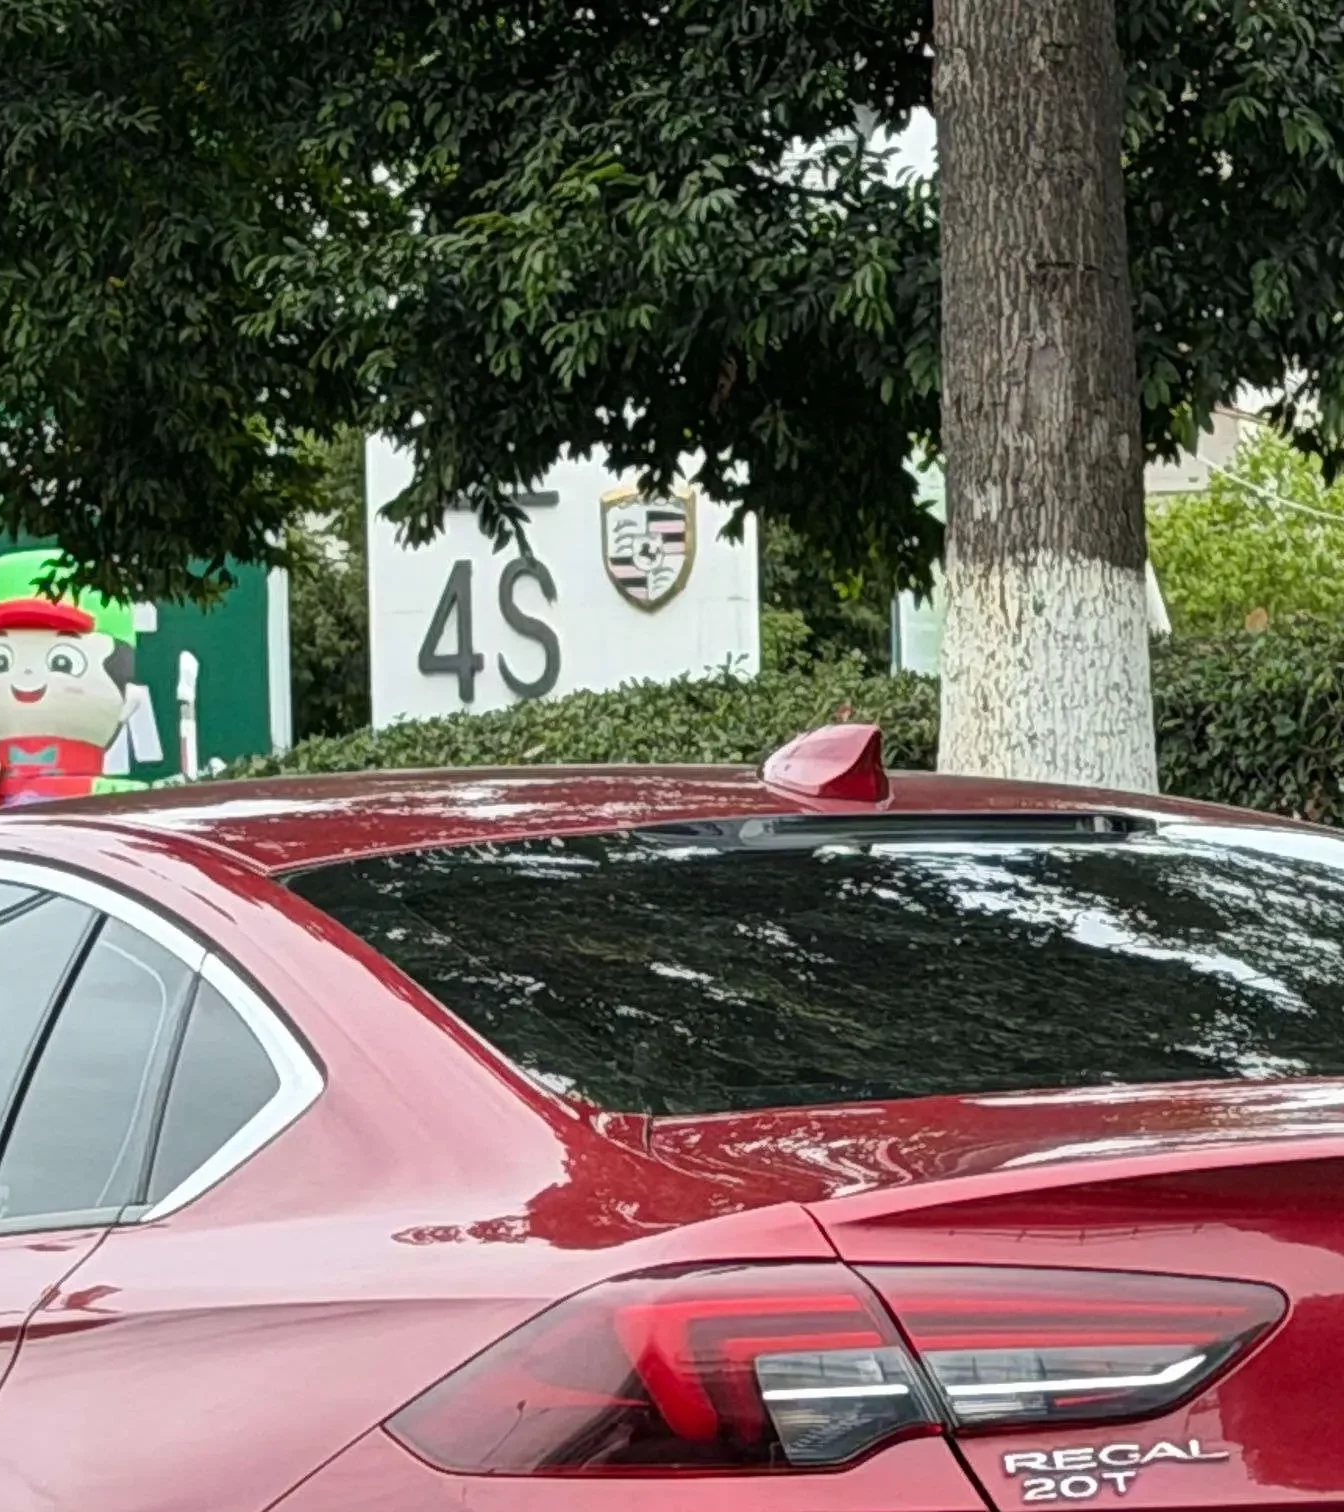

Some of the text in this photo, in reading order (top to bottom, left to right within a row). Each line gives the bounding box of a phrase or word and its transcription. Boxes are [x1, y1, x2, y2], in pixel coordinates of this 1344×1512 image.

[418, 556, 562, 704] 4S
[1003, 1438, 1231, 1475] REGAL
[1022, 1470, 1138, 1501] 20T
